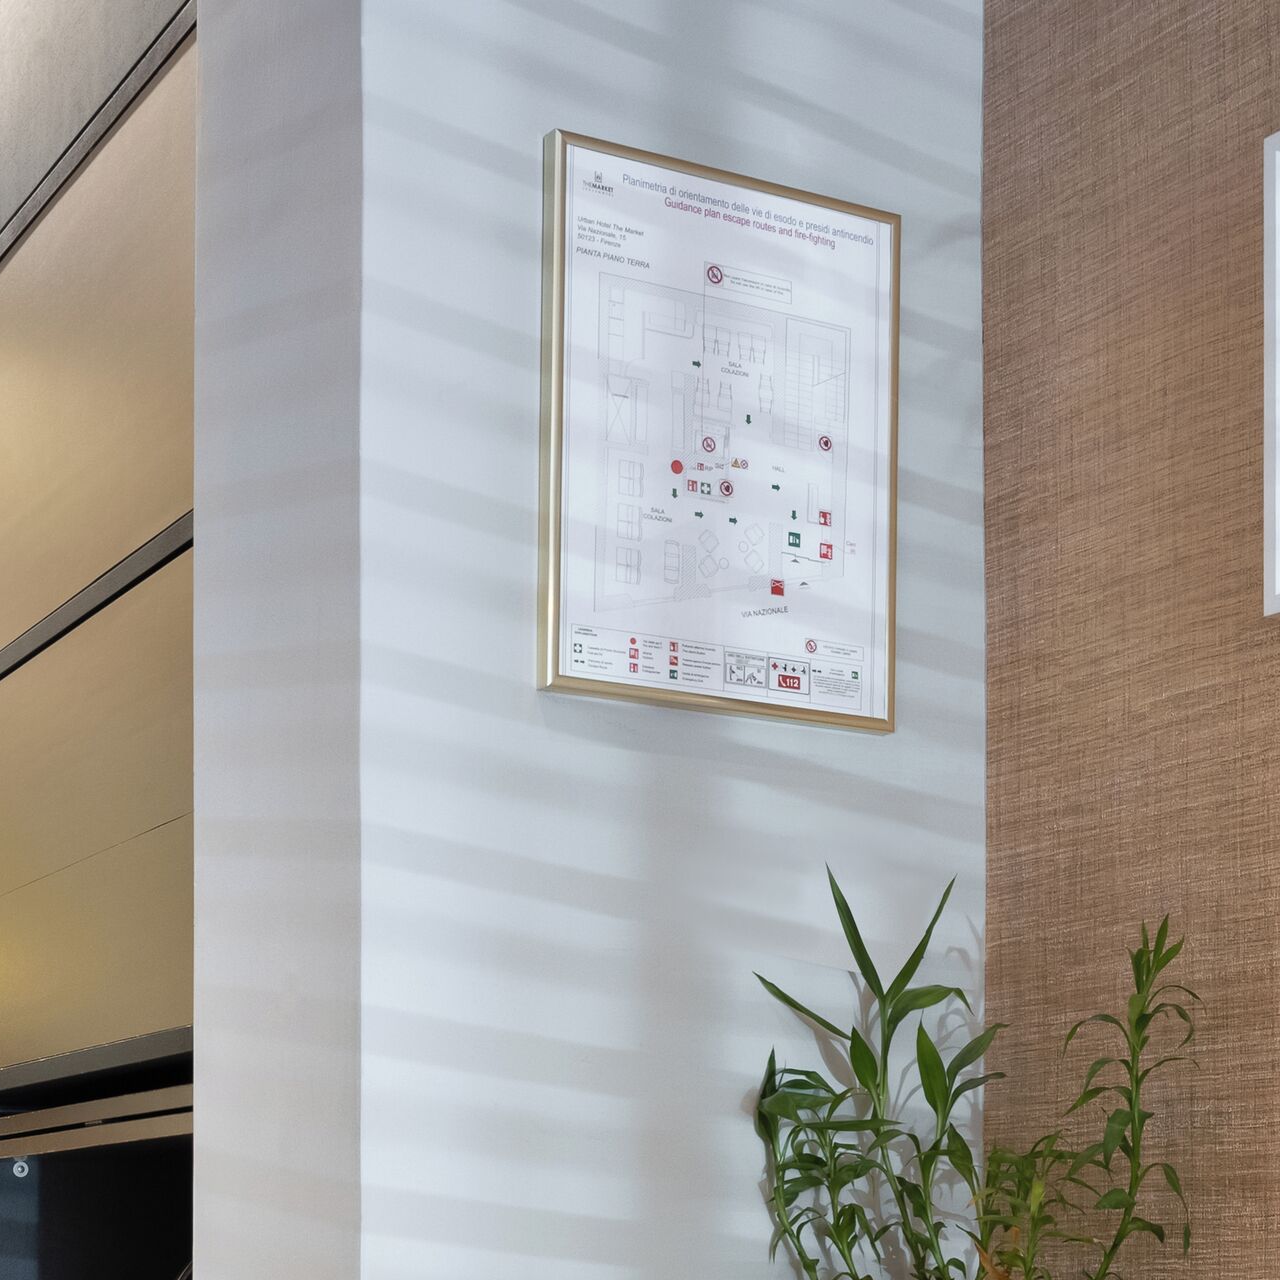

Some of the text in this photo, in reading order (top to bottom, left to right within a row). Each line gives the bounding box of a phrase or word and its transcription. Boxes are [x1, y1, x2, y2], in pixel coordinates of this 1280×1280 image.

[622, 173, 667, 194] Planimetria
[669, 186, 677, 196] di
[678, 190, 730, 210] orientamento
[731, 201, 750, 215] delle
[751, 206, 763, 218] vie
[764, 210, 772, 220] di
[774, 213, 797, 226] esodo
[798, 220, 804, 228] e
[805, 221, 831, 234] presidi
[831, 227, 874, 246] antincendio
[577, 224, 587, 232] Via
[664, 196, 836, 250] Guidance plan escape routes and fire-fighting
[625, 227, 644, 236] Market
[576, 246, 650, 269] PIANTA PIANO TERRA
[728, 361, 742, 369] SALA
[720, 367, 749, 378] COLAZIONI
[651, 507, 665, 515] SALA
[643, 513, 673, 524] COLAZIONI
[741, 605, 789, 618] VIA NAZIONALE
[786, 678, 799, 688] 112
